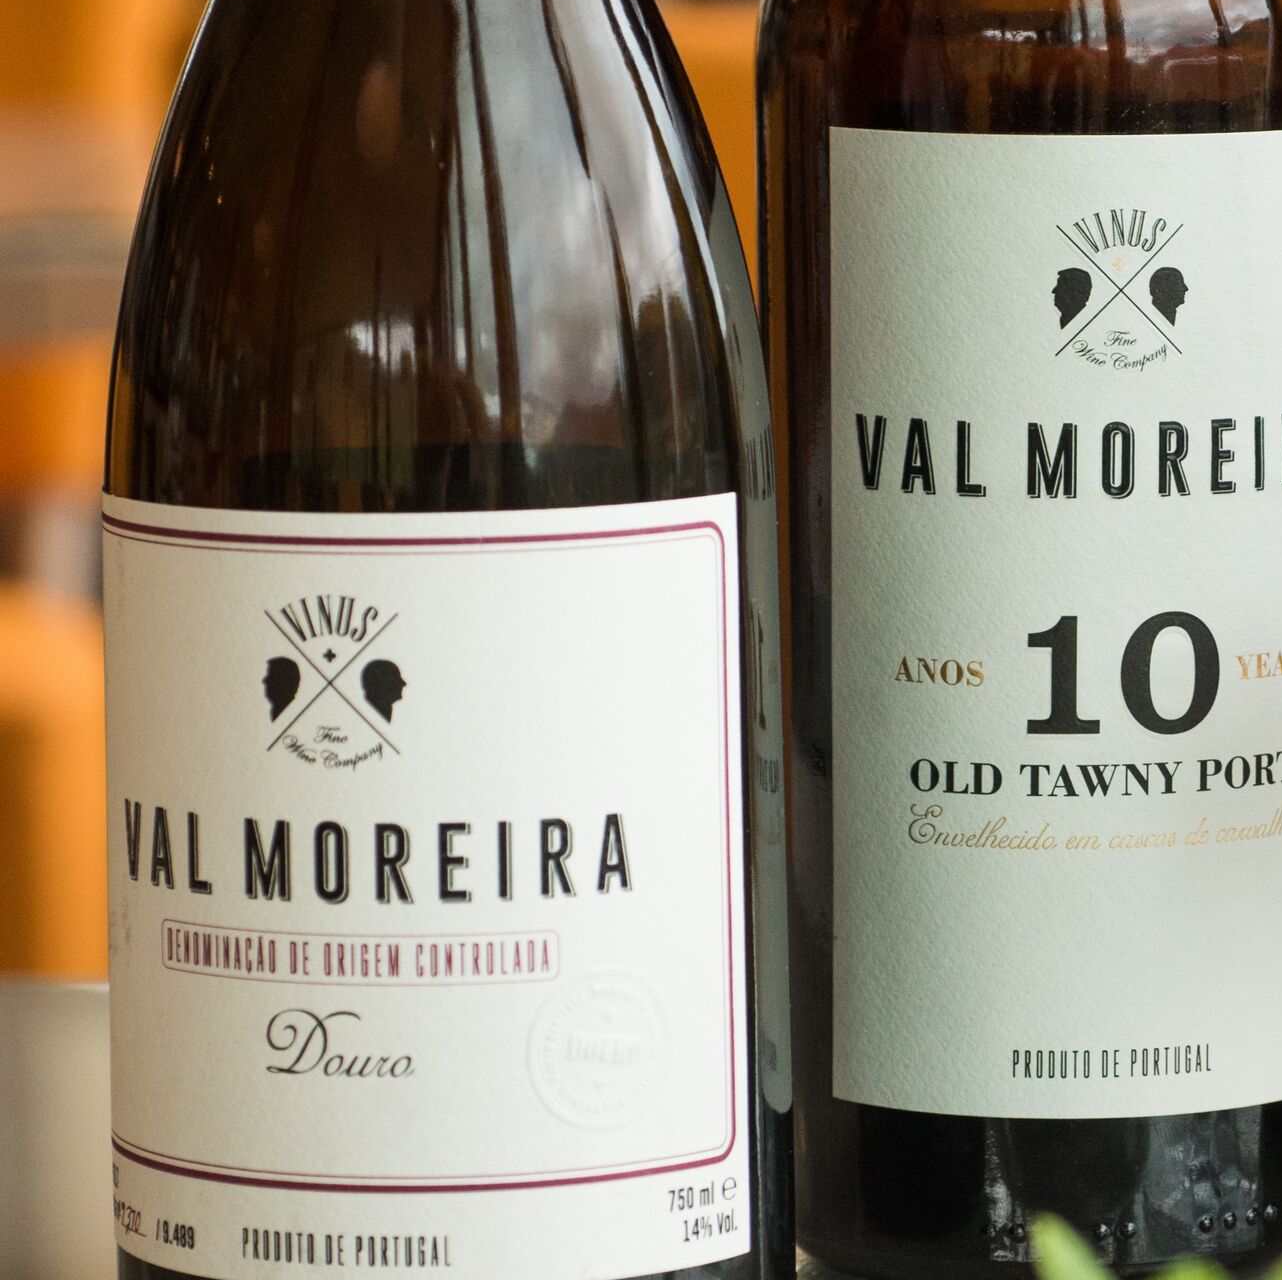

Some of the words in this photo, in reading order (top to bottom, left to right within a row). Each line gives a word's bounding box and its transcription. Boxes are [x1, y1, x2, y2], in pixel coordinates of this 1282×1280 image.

[1073, 208, 1167, 254] VINUS
[1072, 339, 1108, 367] Wine
[1110, 343, 1168, 372] Company
[1103, 330, 1137, 347] Fine
[855, 412, 987, 498] VAL
[281, 594, 378, 643] VINUS
[894, 655, 986, 689] ANOS
[1026, 610, 1221, 736] 10
[282, 734, 317, 765] Wine
[320, 742, 384, 772] Company
[313, 725, 348, 744] Fine
[909, 758, 1003, 796] OLD
[1020, 760, 1183, 798] TAWNY
[908, 802, 1057, 851] Envelhecido
[1065, 831, 1100, 851] em
[1109, 832, 1176, 851] cascos
[1184, 817, 1208, 846] de
[124, 797, 213, 895] VAL
[243, 812, 634, 905] MOREIRA
[166, 927, 278, 978] DENOMINAÇÃO
[290, 940, 311, 977] DE
[323, 941, 401, 979] ORIGEM
[415, 939, 552, 979] CONTROLADA
[266, 1008, 416, 1079] Douro
[1012, 1048, 1091, 1081] PRODUTO
[1101, 1048, 1120, 1079] DE
[1130, 1042, 1212, 1077] PORTUGAL
[668, 1186, 694, 1212] 750
[700, 1180, 715, 1207] ml
[683, 1215, 713, 1242] 14%
[717, 1208, 738, 1235] Vol.
[242, 1226, 316, 1267] PRODUTO
[325, 1232, 346, 1267] DE
[354, 1234, 452, 1268] PORTUGAL
